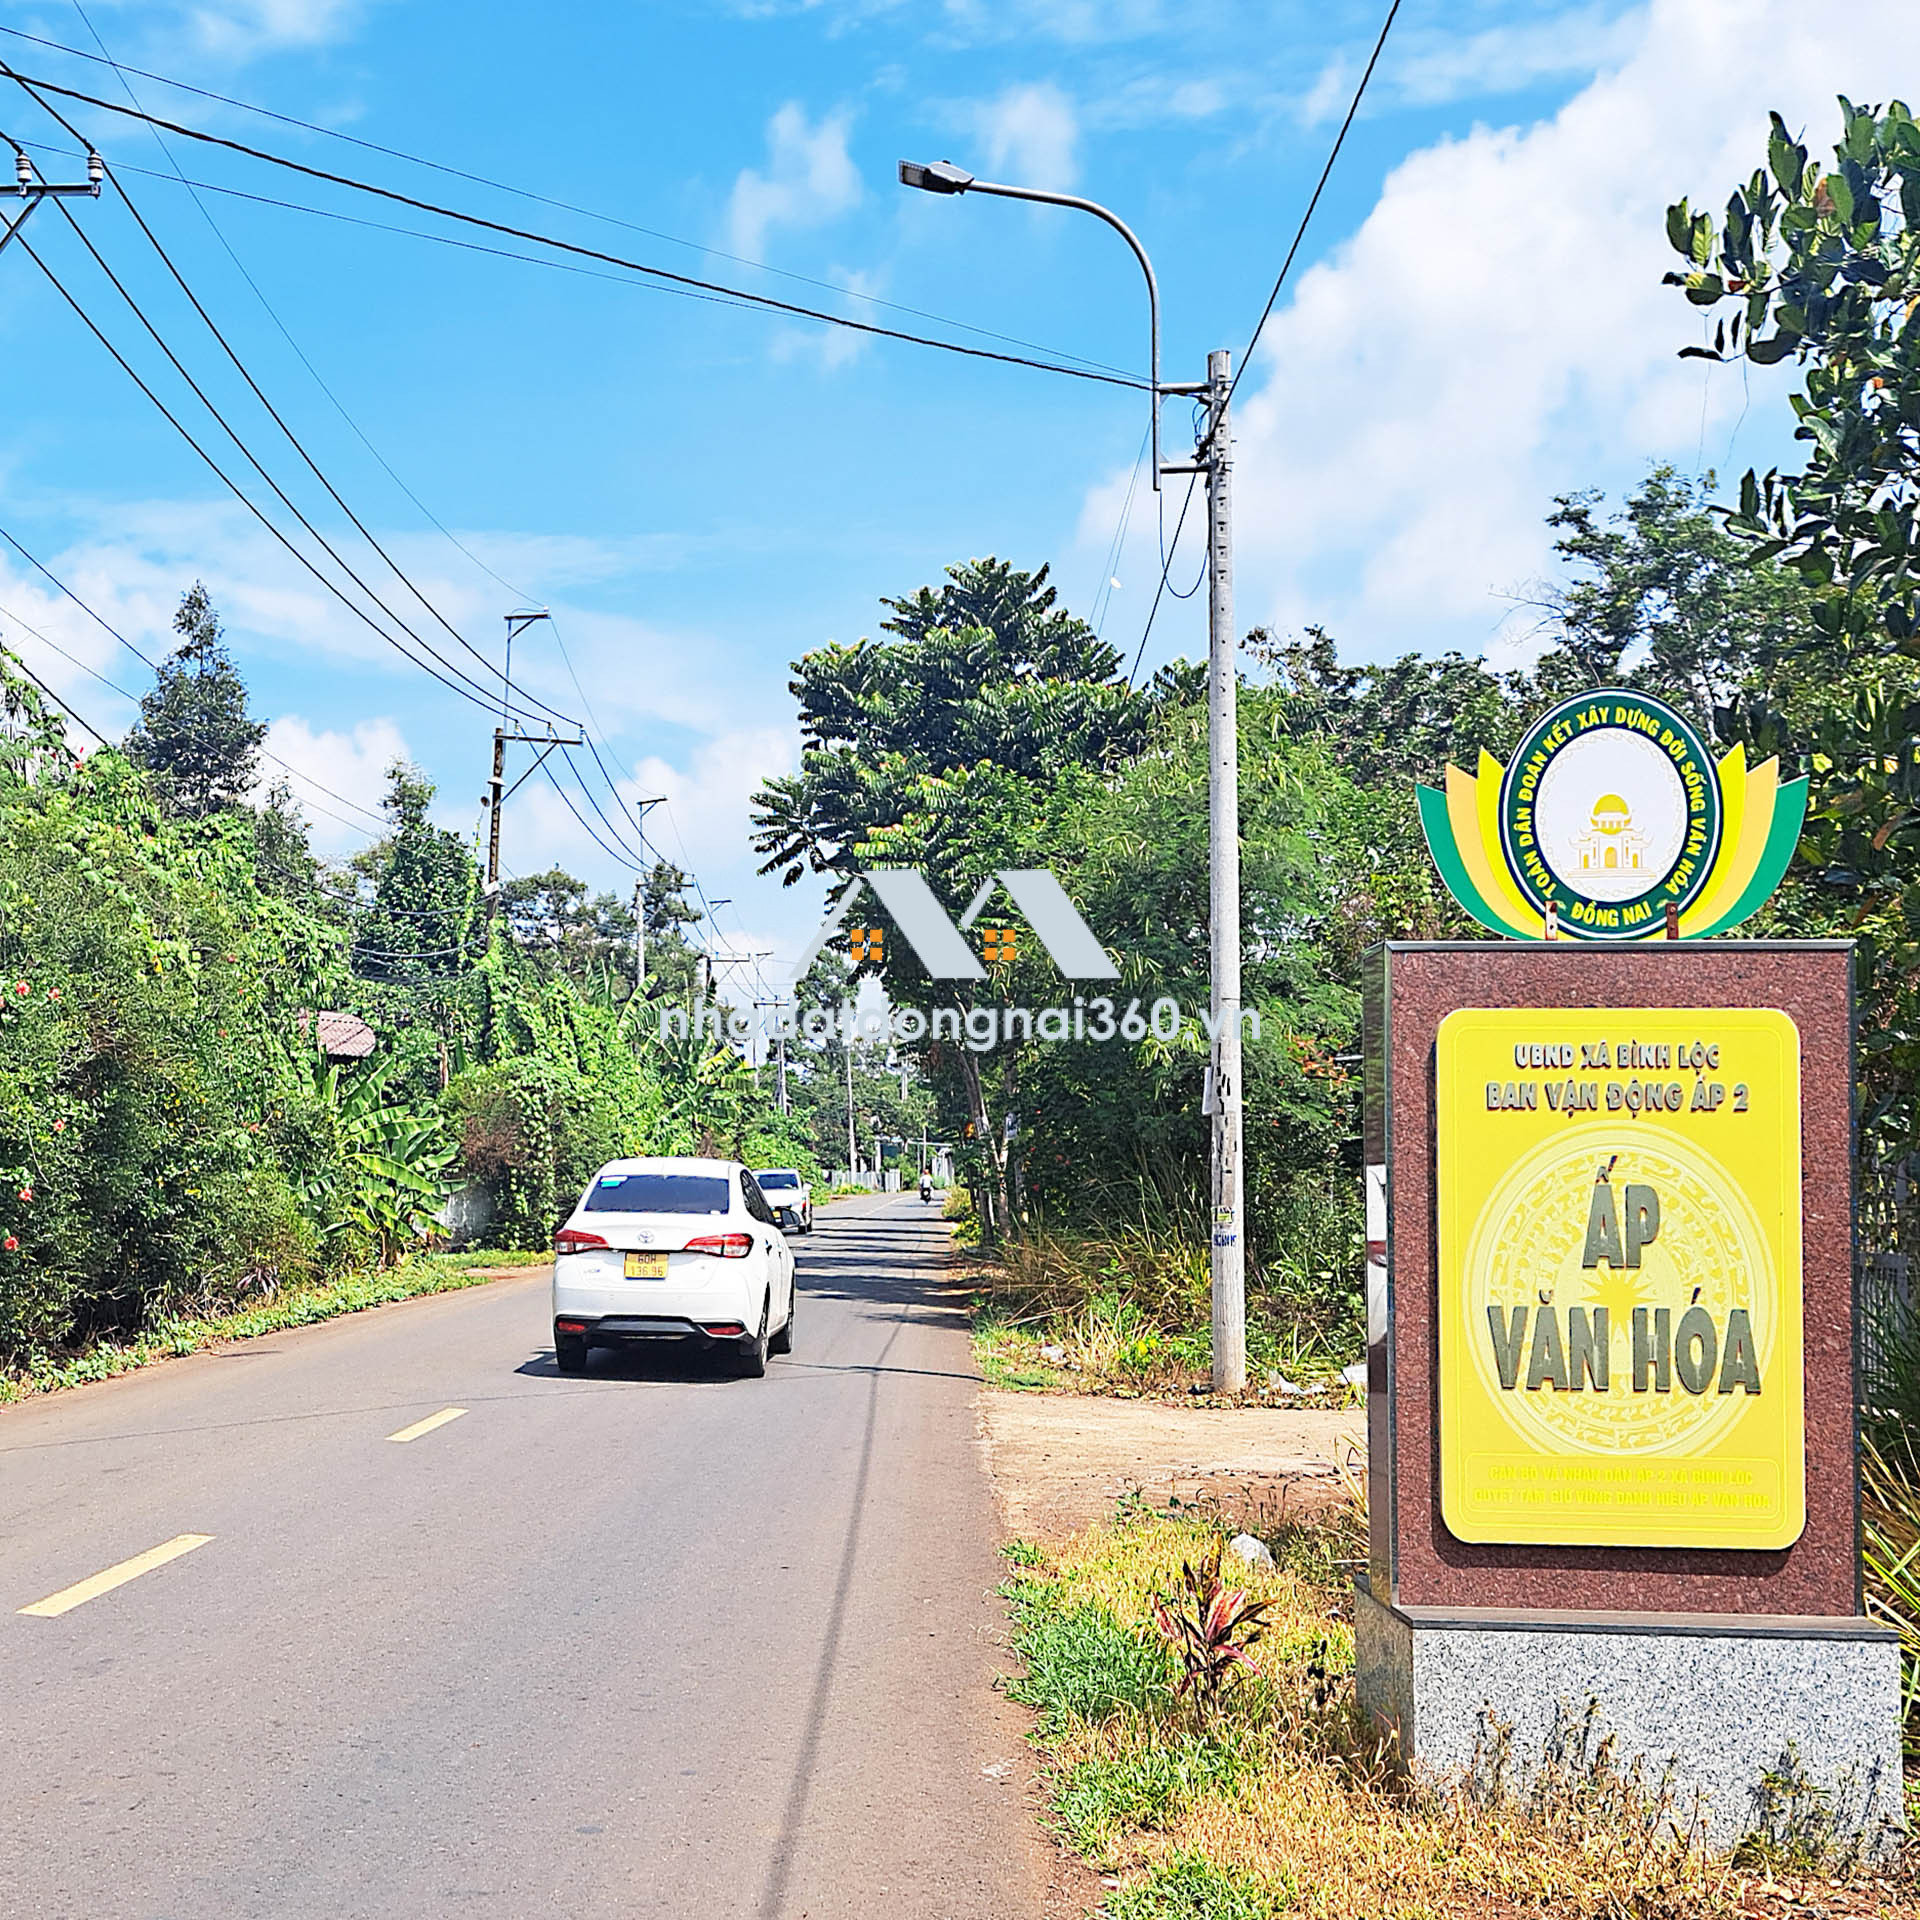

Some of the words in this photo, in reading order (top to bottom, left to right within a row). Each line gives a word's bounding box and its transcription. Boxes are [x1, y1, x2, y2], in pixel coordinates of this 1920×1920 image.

[1542, 719, 1574, 753] KẾT
[1576, 705, 1610, 731] XÂY
[1615, 707, 1661, 737] DỰNG
[1659, 728, 1688, 761] ĐỜI
[1518, 750, 1548, 801] ĐOÀN
[1680, 761, 1707, 812] SỐNG
[1514, 807, 1534, 847] DÂN
[1686, 818, 1708, 856] VĂN
[1523, 849, 1557, 899] TOÀN
[1665, 857, 1695, 895] HÓA
[1571, 900, 1619, 927] ĐỒNG
[1622, 900, 1653, 926] NAI
[1515, 1043, 1575, 1069] UBND
[1617, 1039, 1671, 1069] BÌNH
[1678, 1041, 1720, 1076] LỘC
[1486, 1082, 1537, 1111] BAN
[1545, 1079, 1599, 1119] VẬN
[1606, 1080, 1684, 1119] ĐỘNG
[1690, 1075, 1726, 1112] ẤP
[1733, 1083, 1749, 1112] 2
[1582, 1155, 1661, 1270] ẤP
[1487, 1288, 1610, 1392] VĂN
[1632, 1287, 1762, 1396] HÓA
